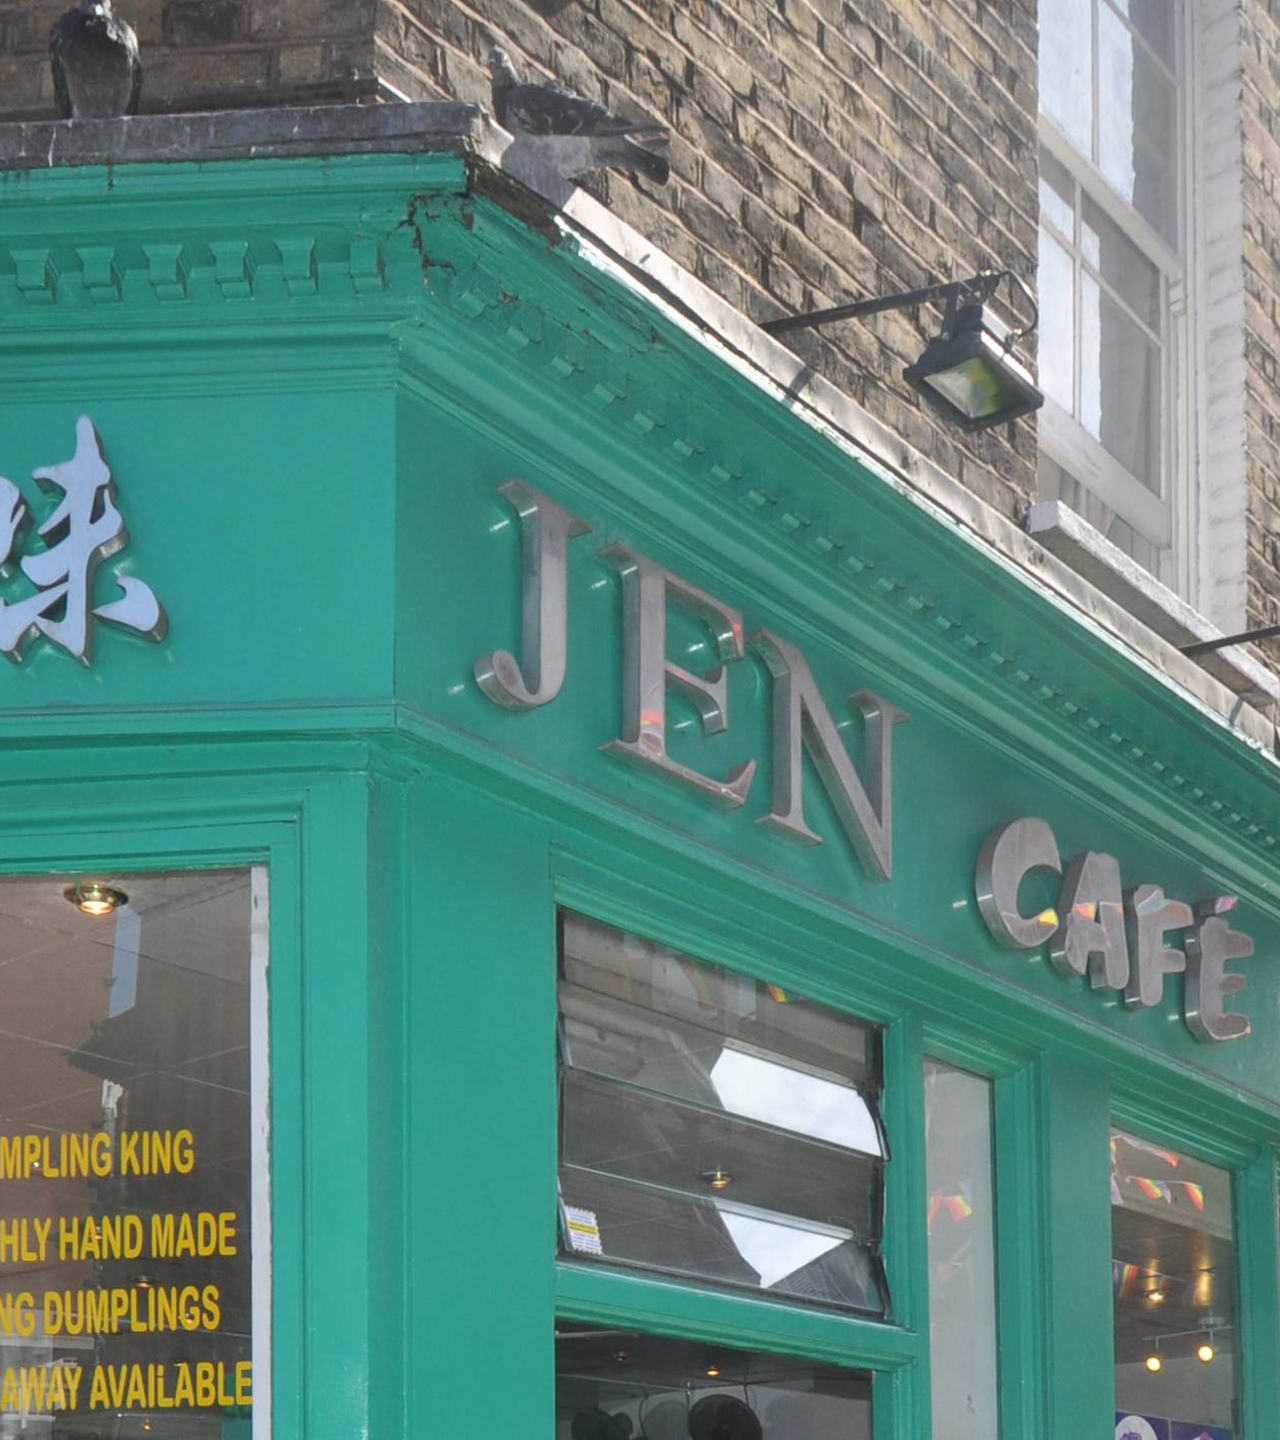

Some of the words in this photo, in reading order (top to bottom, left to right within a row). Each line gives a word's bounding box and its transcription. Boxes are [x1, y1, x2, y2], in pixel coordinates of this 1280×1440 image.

[474, 478, 910, 881] JEN
[975, 817, 1255, 1042] CAFÉ
[121, 1129, 194, 1176] KING
[59, 1214, 143, 1260] HAND
[151, 1212, 237, 1258] MADE
[44, 1285, 220, 1335] DUMPLINGS
[90, 1361, 253, 1410] AVAILABLE
